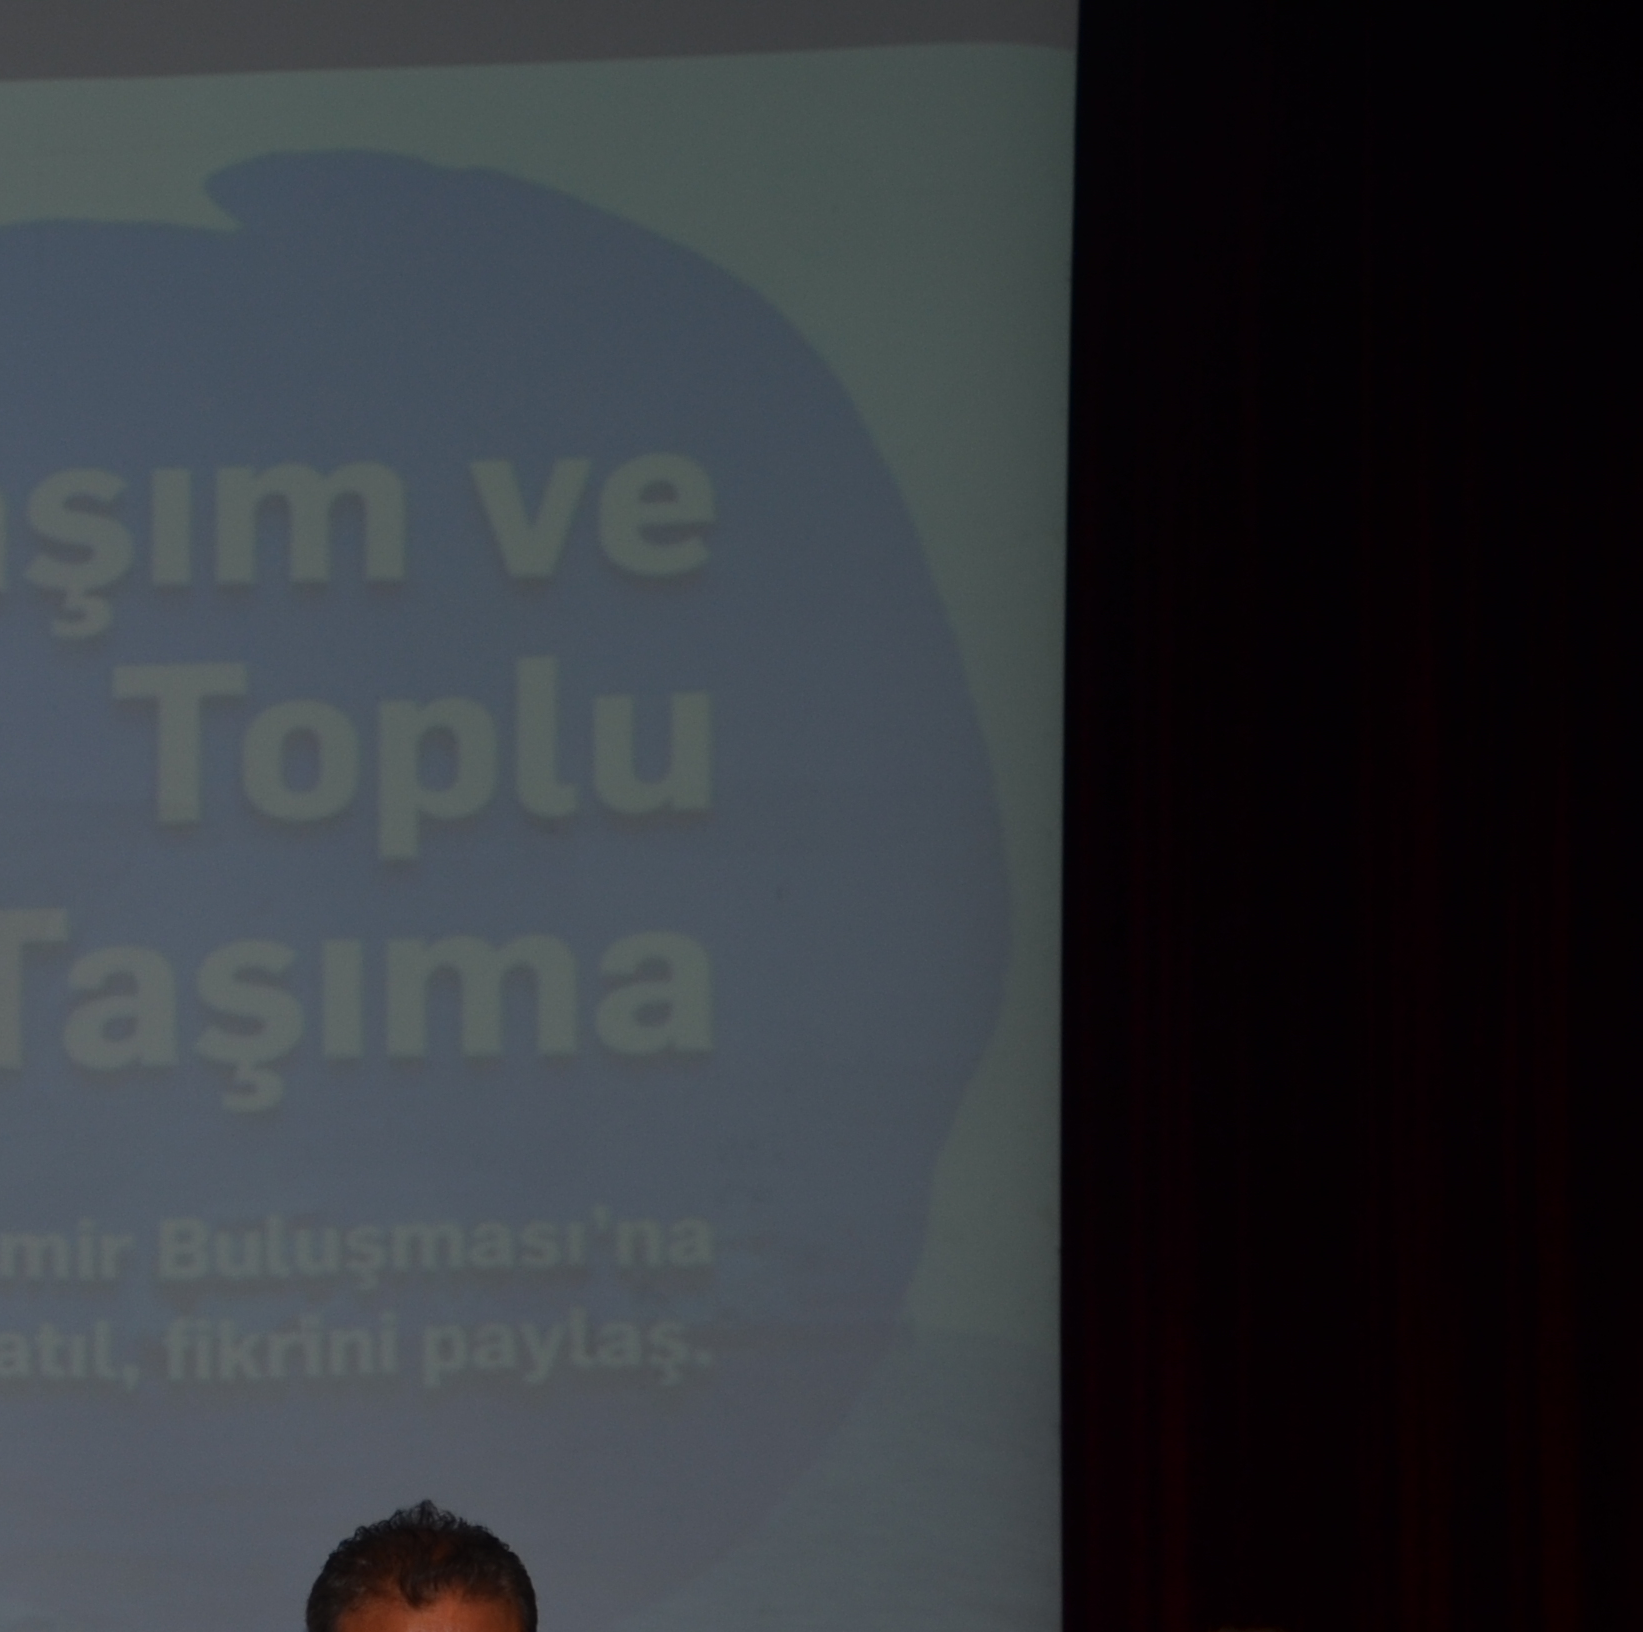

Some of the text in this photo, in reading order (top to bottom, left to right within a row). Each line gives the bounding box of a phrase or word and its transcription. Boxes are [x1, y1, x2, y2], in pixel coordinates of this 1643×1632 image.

[473, 446, 717, 578] ve
[112, 656, 717, 866] Toplu
[156, 1204, 716, 1291] Buluşması'na
[162, 1312, 404, 1384] fikrini
[419, 1309, 715, 1390] paylaş.
